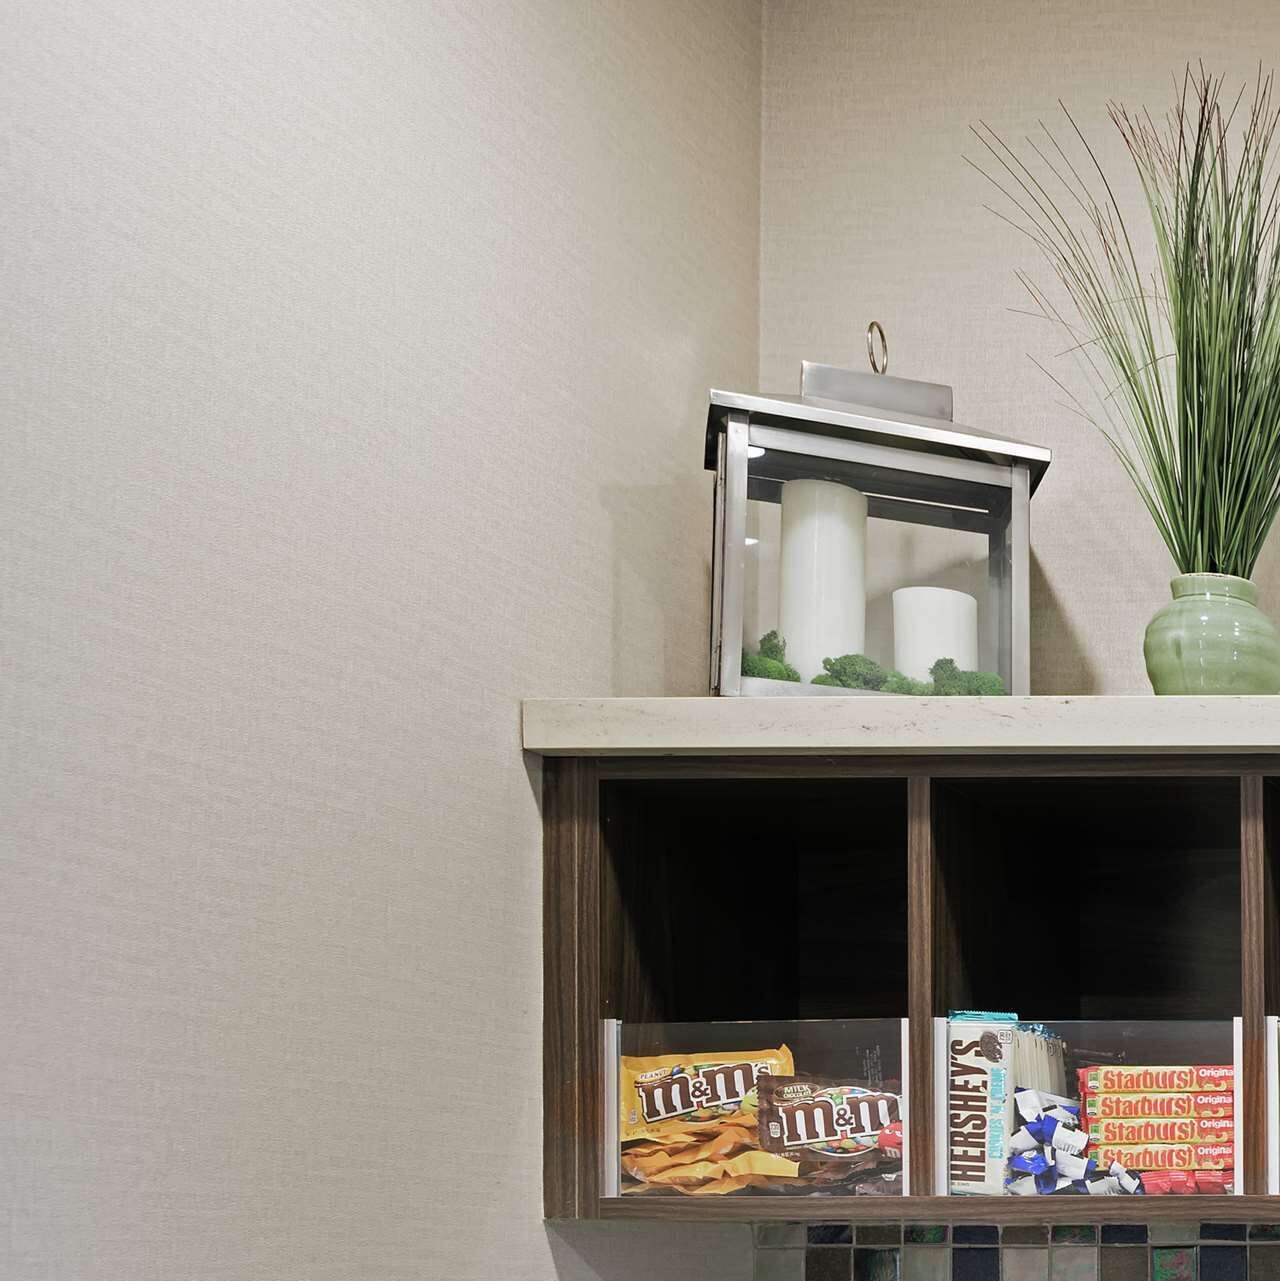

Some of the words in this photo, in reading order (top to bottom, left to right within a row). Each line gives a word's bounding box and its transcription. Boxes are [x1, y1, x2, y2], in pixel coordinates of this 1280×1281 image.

[783, 1084, 810, 1093] MILK
[1102, 1069, 1194, 1091] Starburst
[1199, 1068, 1233, 1078] Origina
[950, 1038, 988, 1183] HERSHEY'S
[1101, 1096, 1193, 1117] Starburst
[1104, 1120, 1197, 1142] Starburst
[1200, 1119, 1233, 1129] Origina
[1102, 1145, 1195, 1169] Starburst
